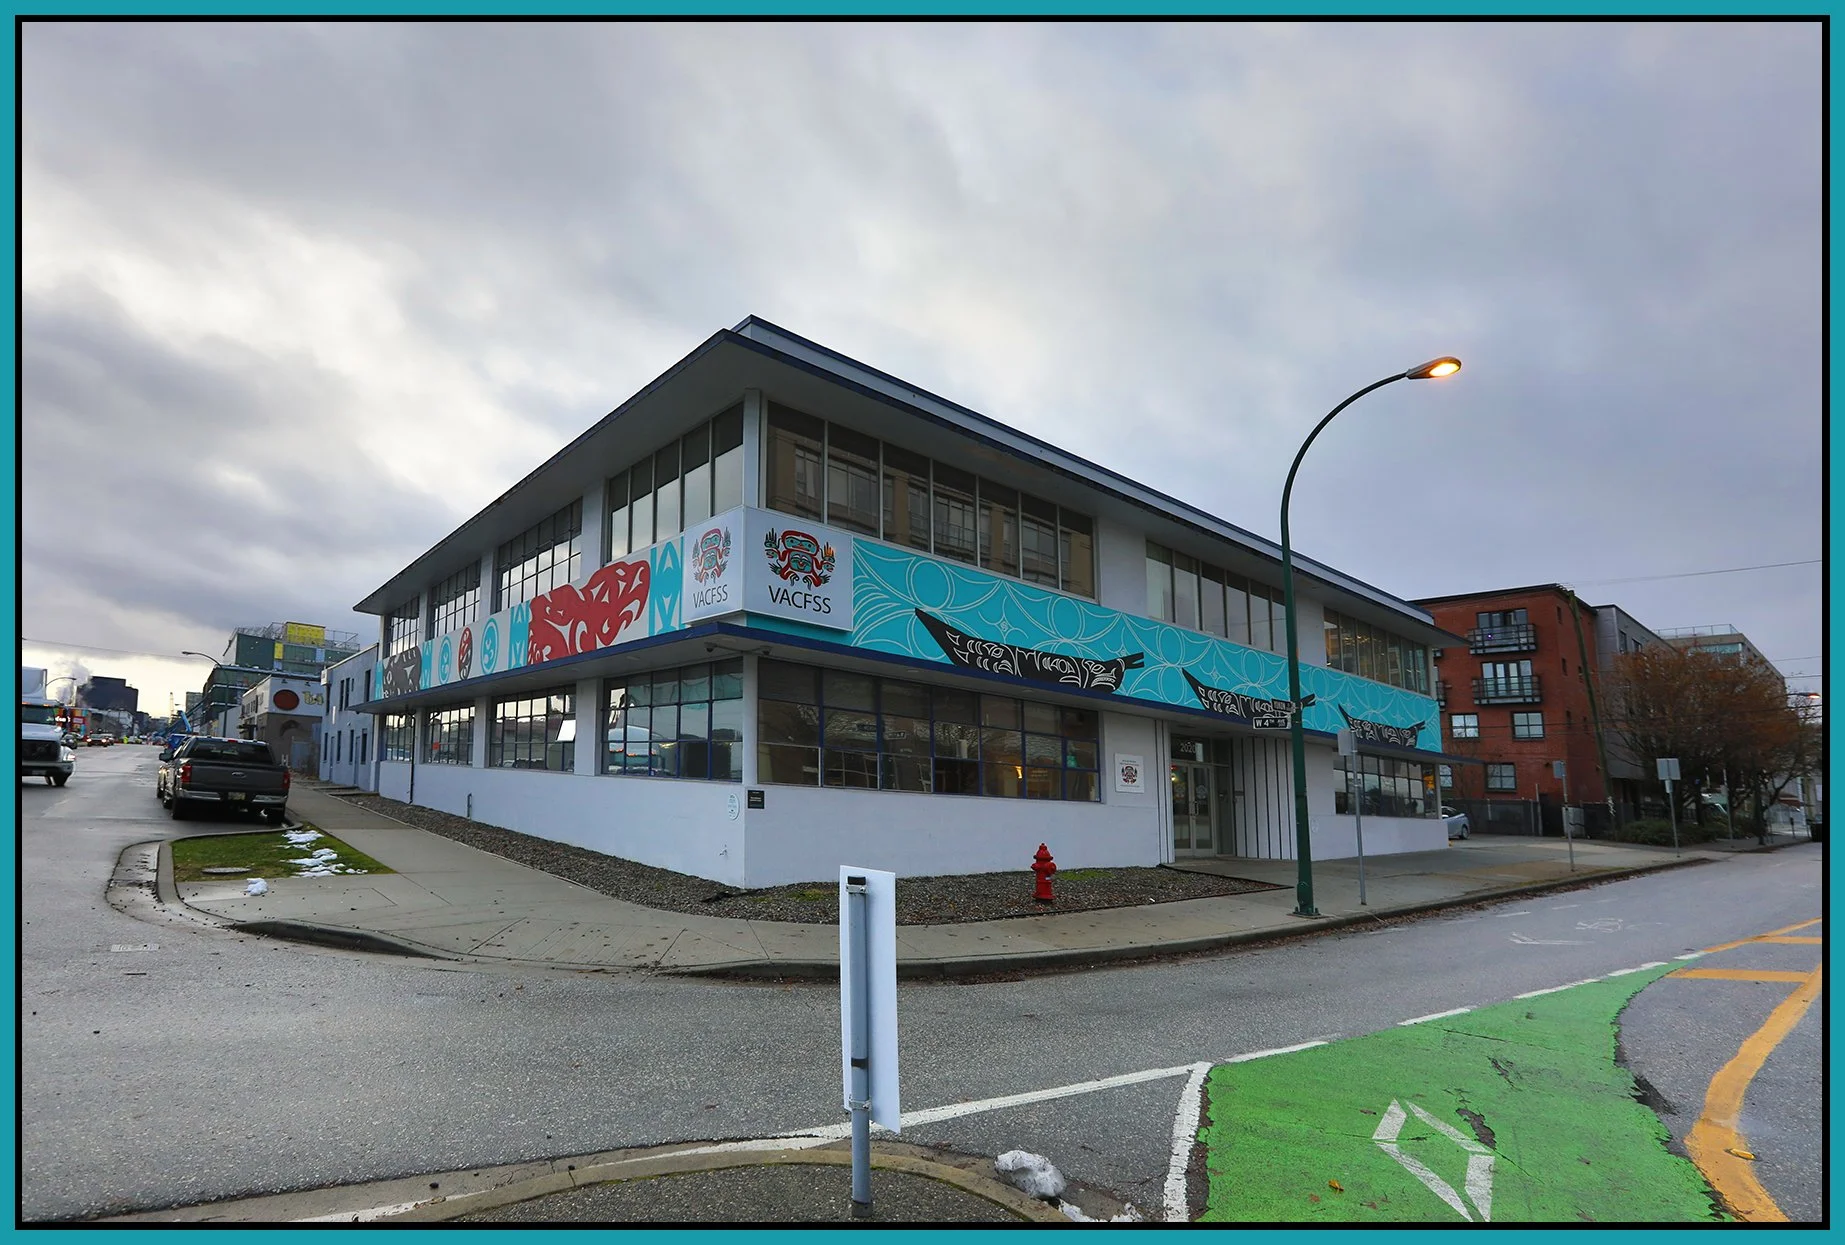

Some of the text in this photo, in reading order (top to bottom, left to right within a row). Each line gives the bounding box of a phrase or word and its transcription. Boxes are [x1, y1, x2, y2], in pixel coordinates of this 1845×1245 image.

[693, 584, 728, 608] VACFSS
[768, 585, 831, 614] VACFSS
[1256, 719, 1262, 727] W
